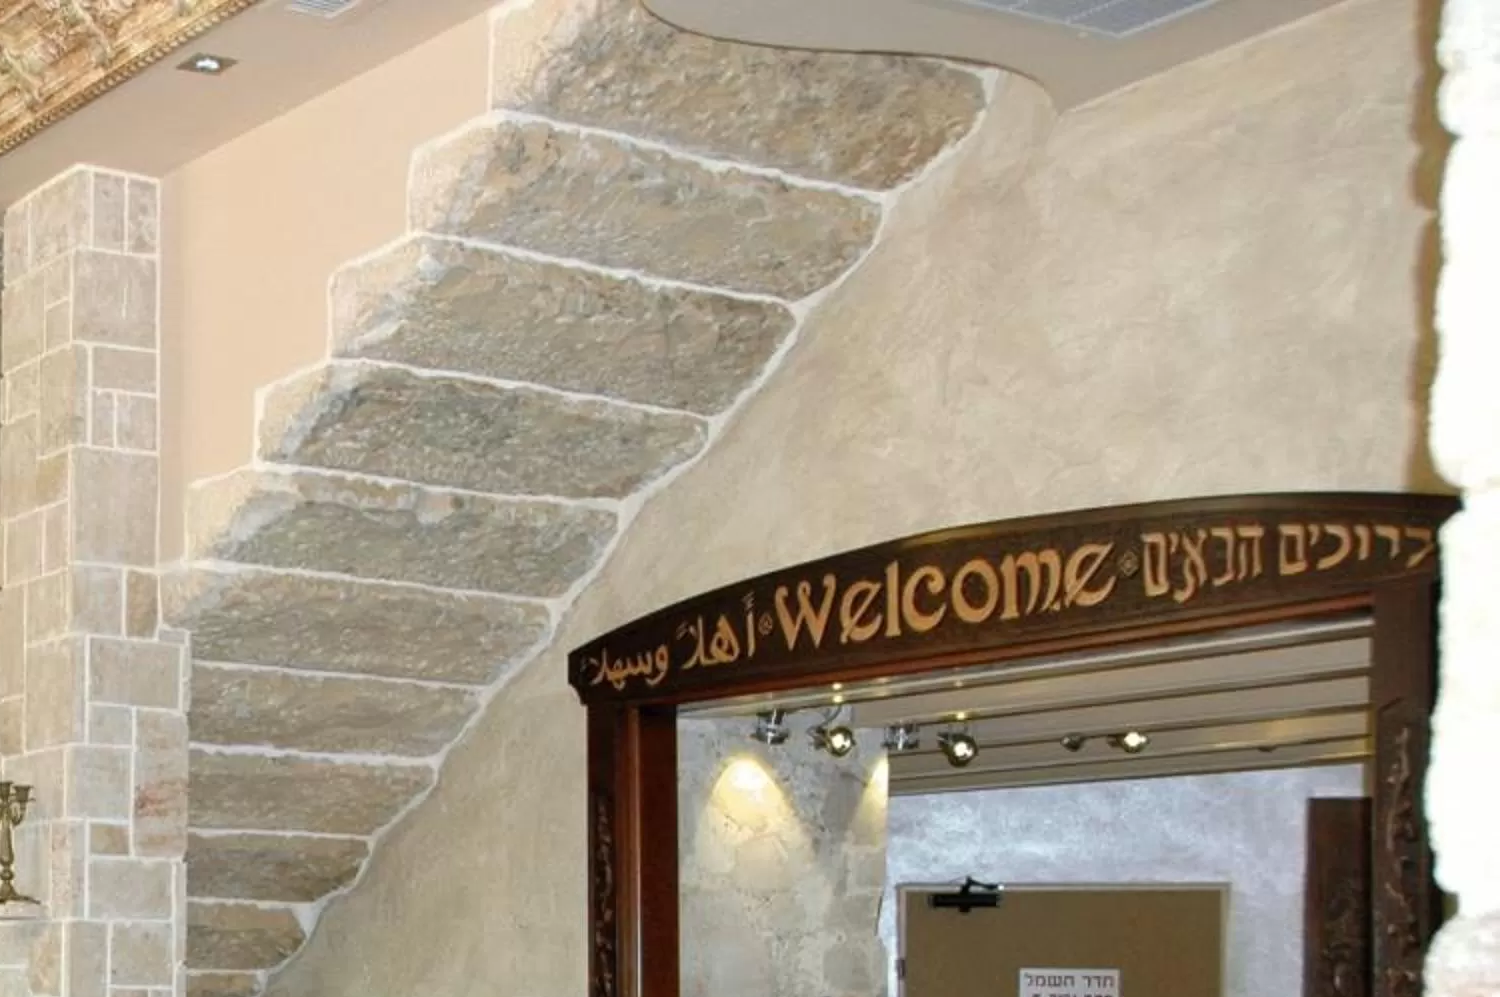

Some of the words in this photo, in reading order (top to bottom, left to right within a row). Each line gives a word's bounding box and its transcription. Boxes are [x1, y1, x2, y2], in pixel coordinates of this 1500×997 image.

[1140, 525, 1264, 604] הבאים
[774, 542, 1114, 650] Welcome
[1025, 972, 1075, 988] חשמל
[1082, 975, 1114, 988] חדר
